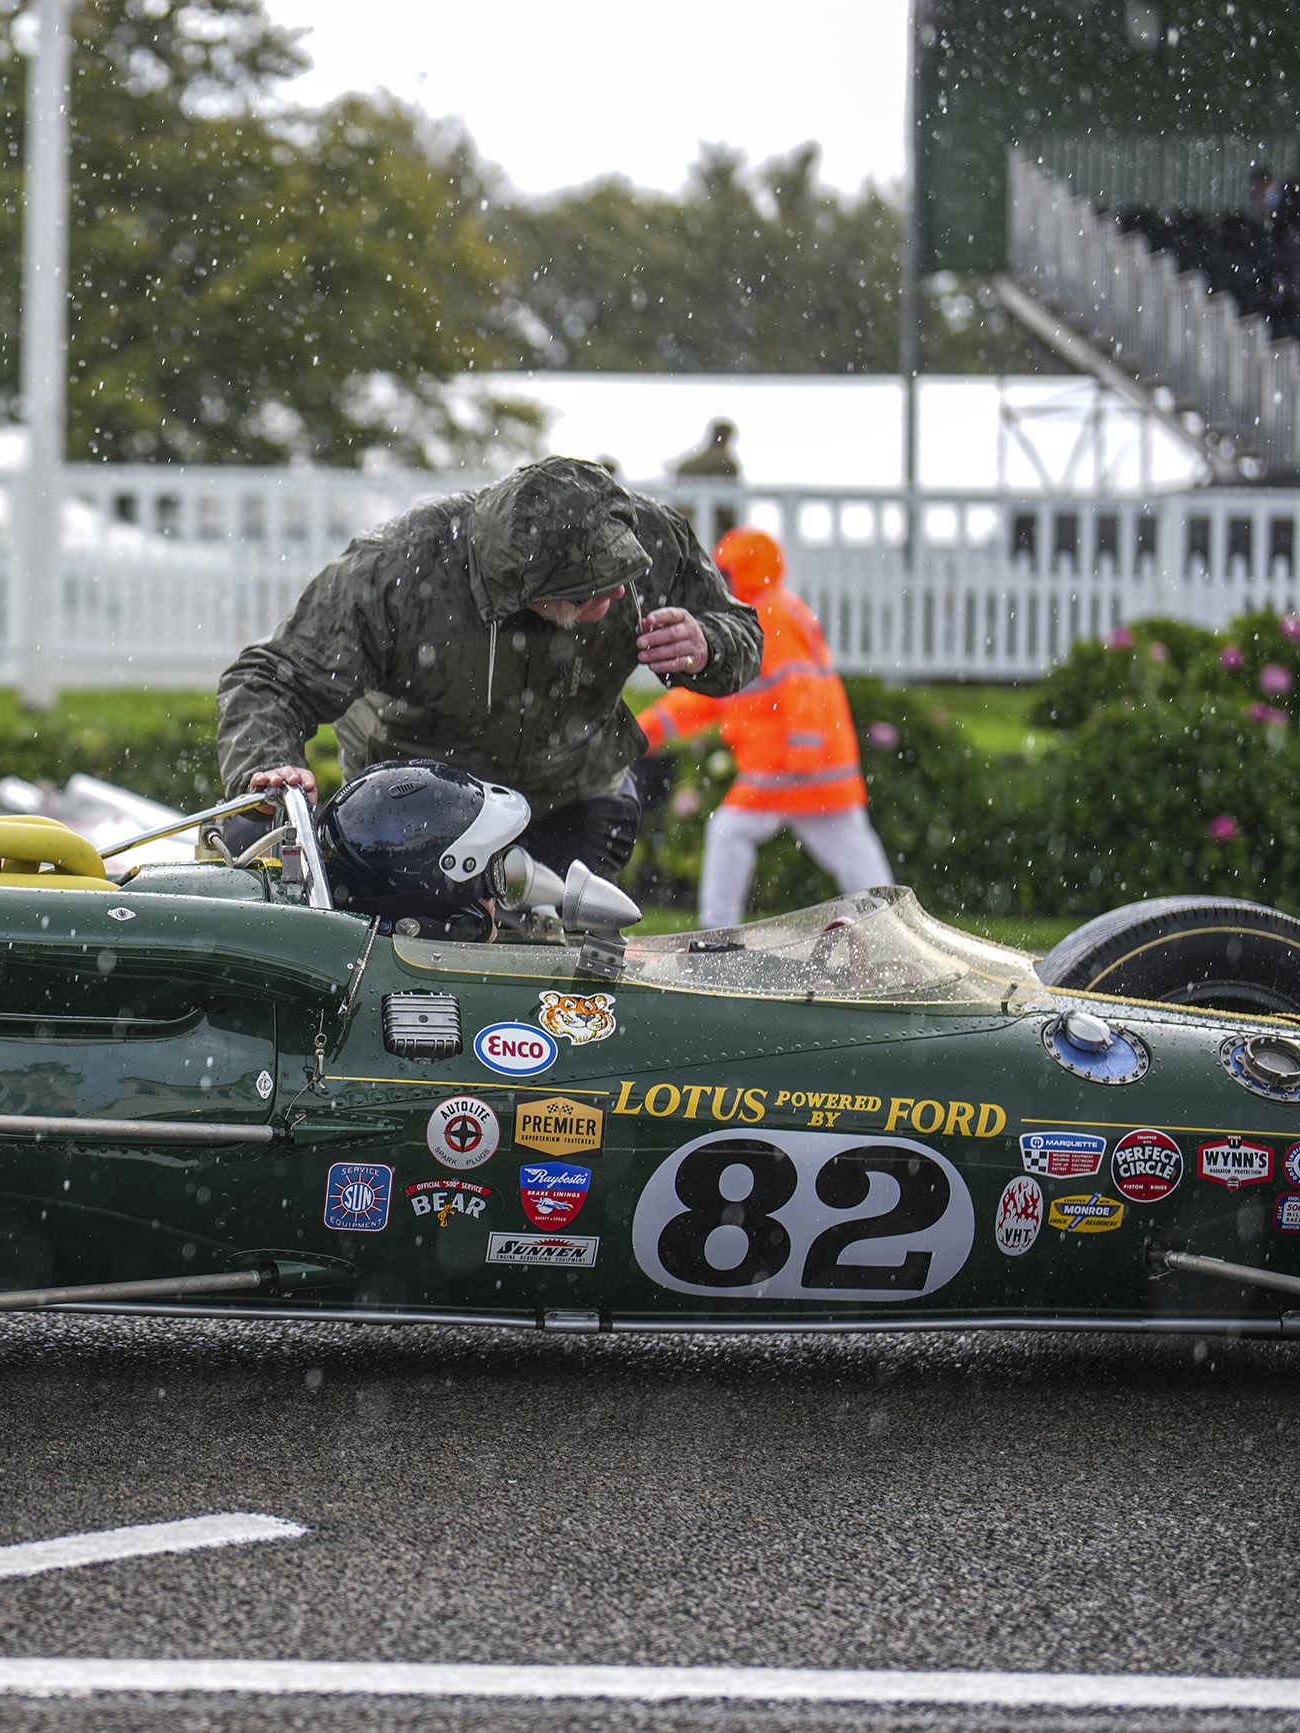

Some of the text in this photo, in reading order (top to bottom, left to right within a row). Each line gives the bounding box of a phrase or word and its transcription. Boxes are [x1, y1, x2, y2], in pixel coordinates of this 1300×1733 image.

[488, 1035, 543, 1058] ENCO
[440, 1101, 490, 1122] AUTOLITE
[611, 1081, 1007, 1138] LOTUS POWERED FORD
[522, 1115, 596, 1136] PREMIER
[807, 1111, 842, 1127] BY
[564, 1137, 595, 1145] FASTENERS
[1045, 1140, 1098, 1148] MARQUETTE
[435, 1147, 490, 1166] SPARK PLUGS
[1116, 1146, 1179, 1166] PERFECT
[1205, 1151, 1267, 1168] WYNN'S
[341, 1166, 380, 1177] SERVICE
[525, 1168, 587, 1189] Raybestos
[1119, 1161, 1174, 1179] CIRCLE
[416, 1181, 440, 1190] OFFICIAL
[461, 1182, 483, 1193] SERVICE
[344, 1185, 372, 1211] SUN
[411, 1192, 486, 1219] BEAR
[657, 1138, 951, 1291] 82
[1063, 1205, 1110, 1216] MONROE
[330, 1216, 383, 1228] EQUIPMENT
[1005, 1228, 1032, 1243] VHT
[497, 1240, 588, 1258] SUNNEN
